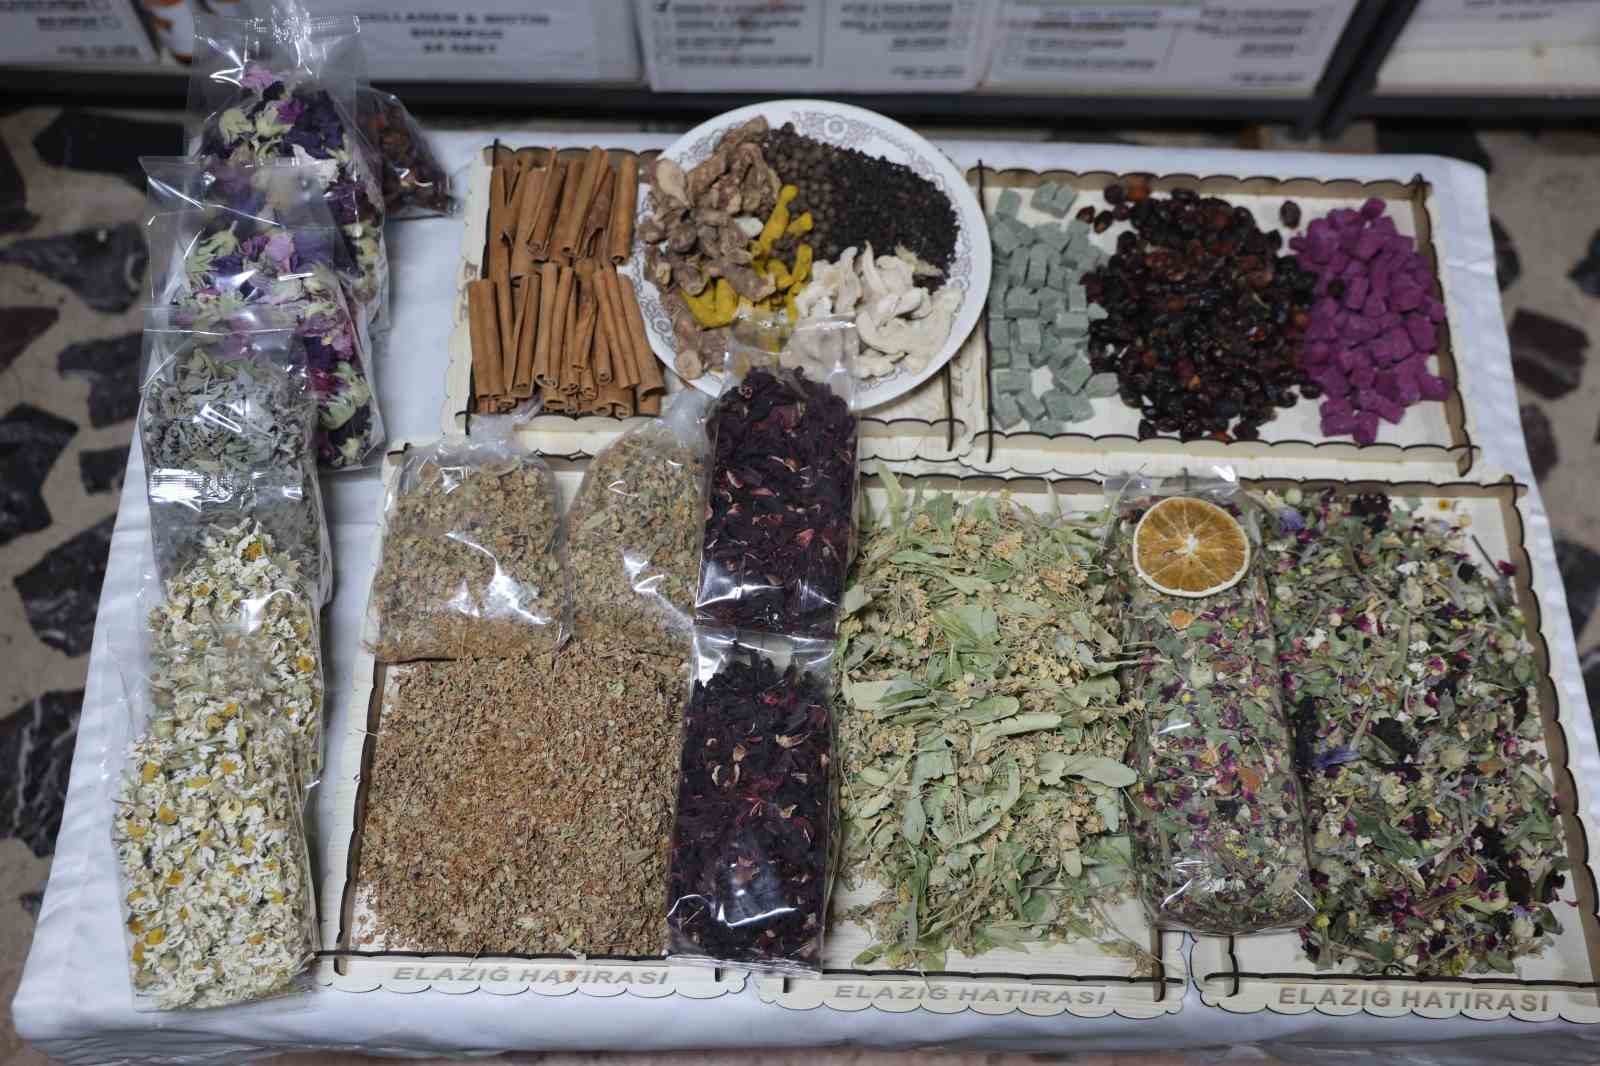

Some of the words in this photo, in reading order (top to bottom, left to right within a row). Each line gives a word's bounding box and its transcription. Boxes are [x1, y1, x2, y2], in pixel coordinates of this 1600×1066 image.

[394, 965, 509, 981] ELAZIĞ
[958, 986, 1106, 1004] HATIRASI
[1279, 985, 1391, 1008] ELAZIĞ
[1402, 990, 1549, 1012] HATIRASI
